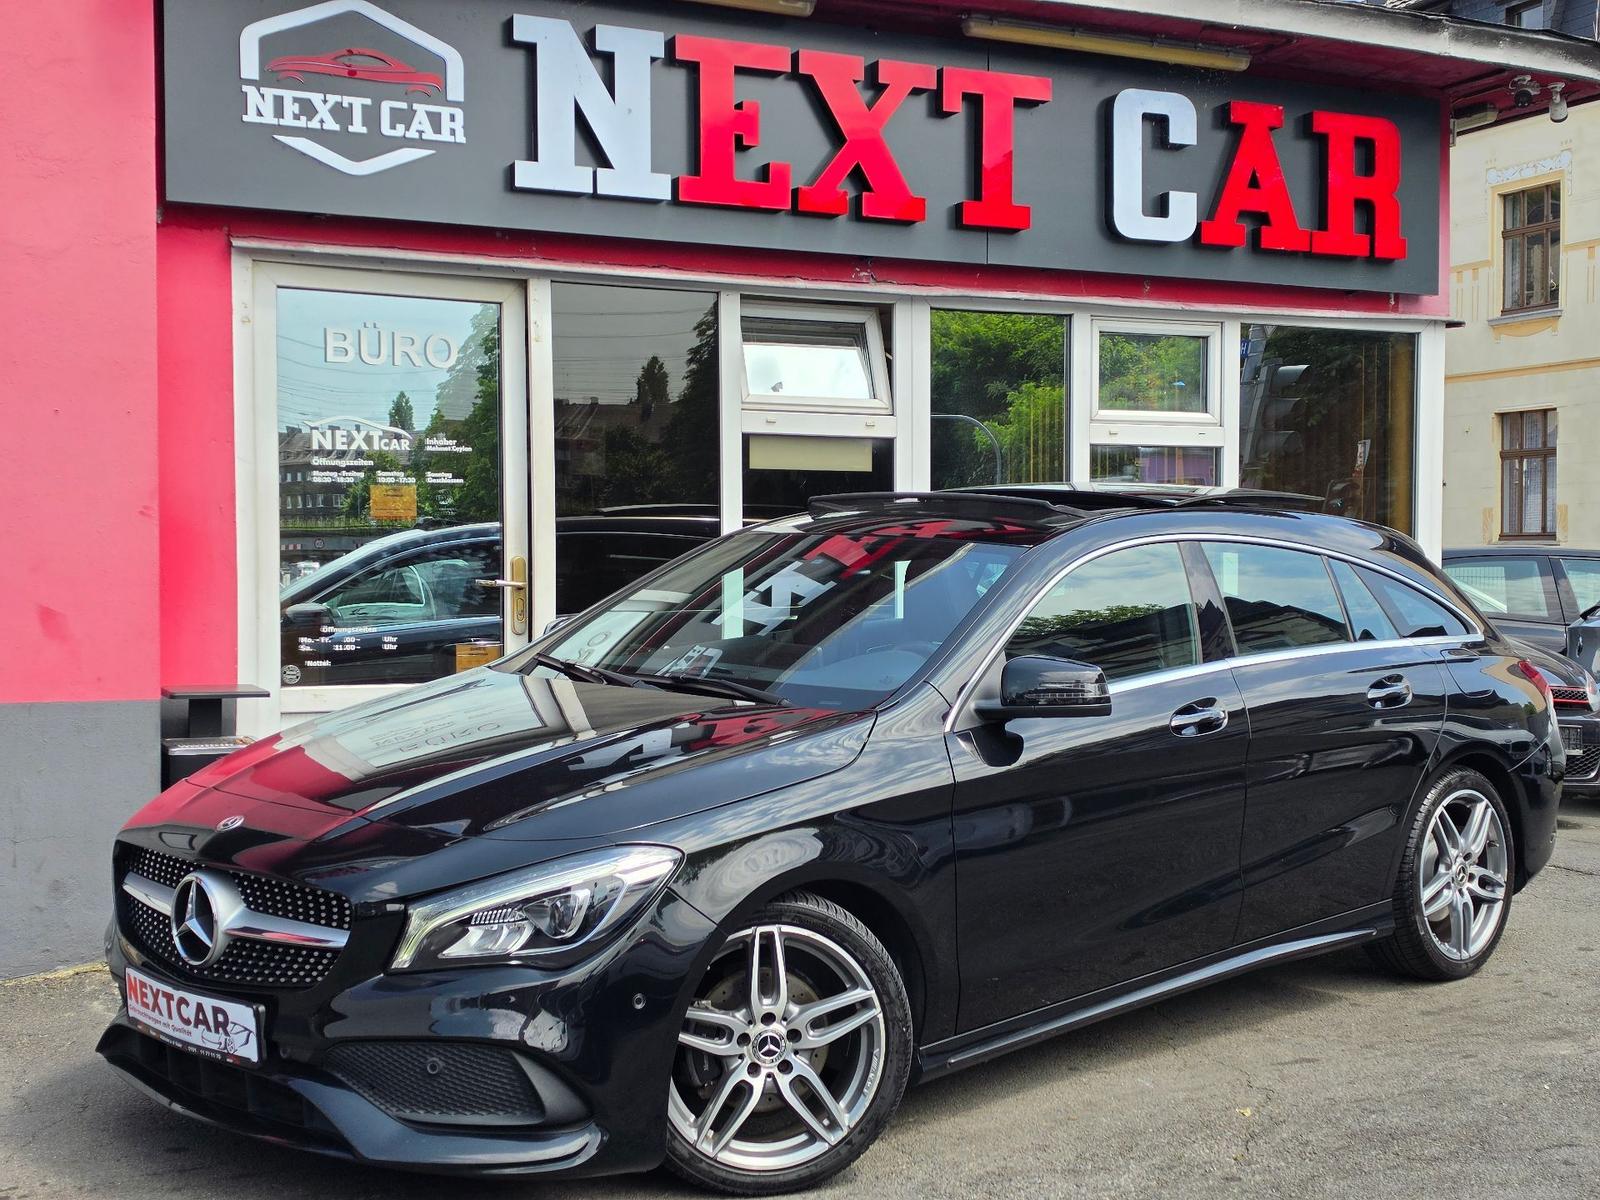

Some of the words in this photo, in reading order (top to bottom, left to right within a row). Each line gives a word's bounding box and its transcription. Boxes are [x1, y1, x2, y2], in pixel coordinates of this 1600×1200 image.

[241, 84, 372, 134] NEXT
[380, 101, 467, 144] CAR
[512, 13, 1052, 232] NEXT
[1112, 87, 1408, 260] CAR
[323, 321, 458, 370] BÜRO
[427, 437, 458, 447] Inhaber
[311, 456, 374, 468] Öffnungszeiten
[376, 470, 405, 479] Samstag
[321, 625, 378, 634] Öffnungszeiten
[127, 973, 232, 1038] NEXTCAR
